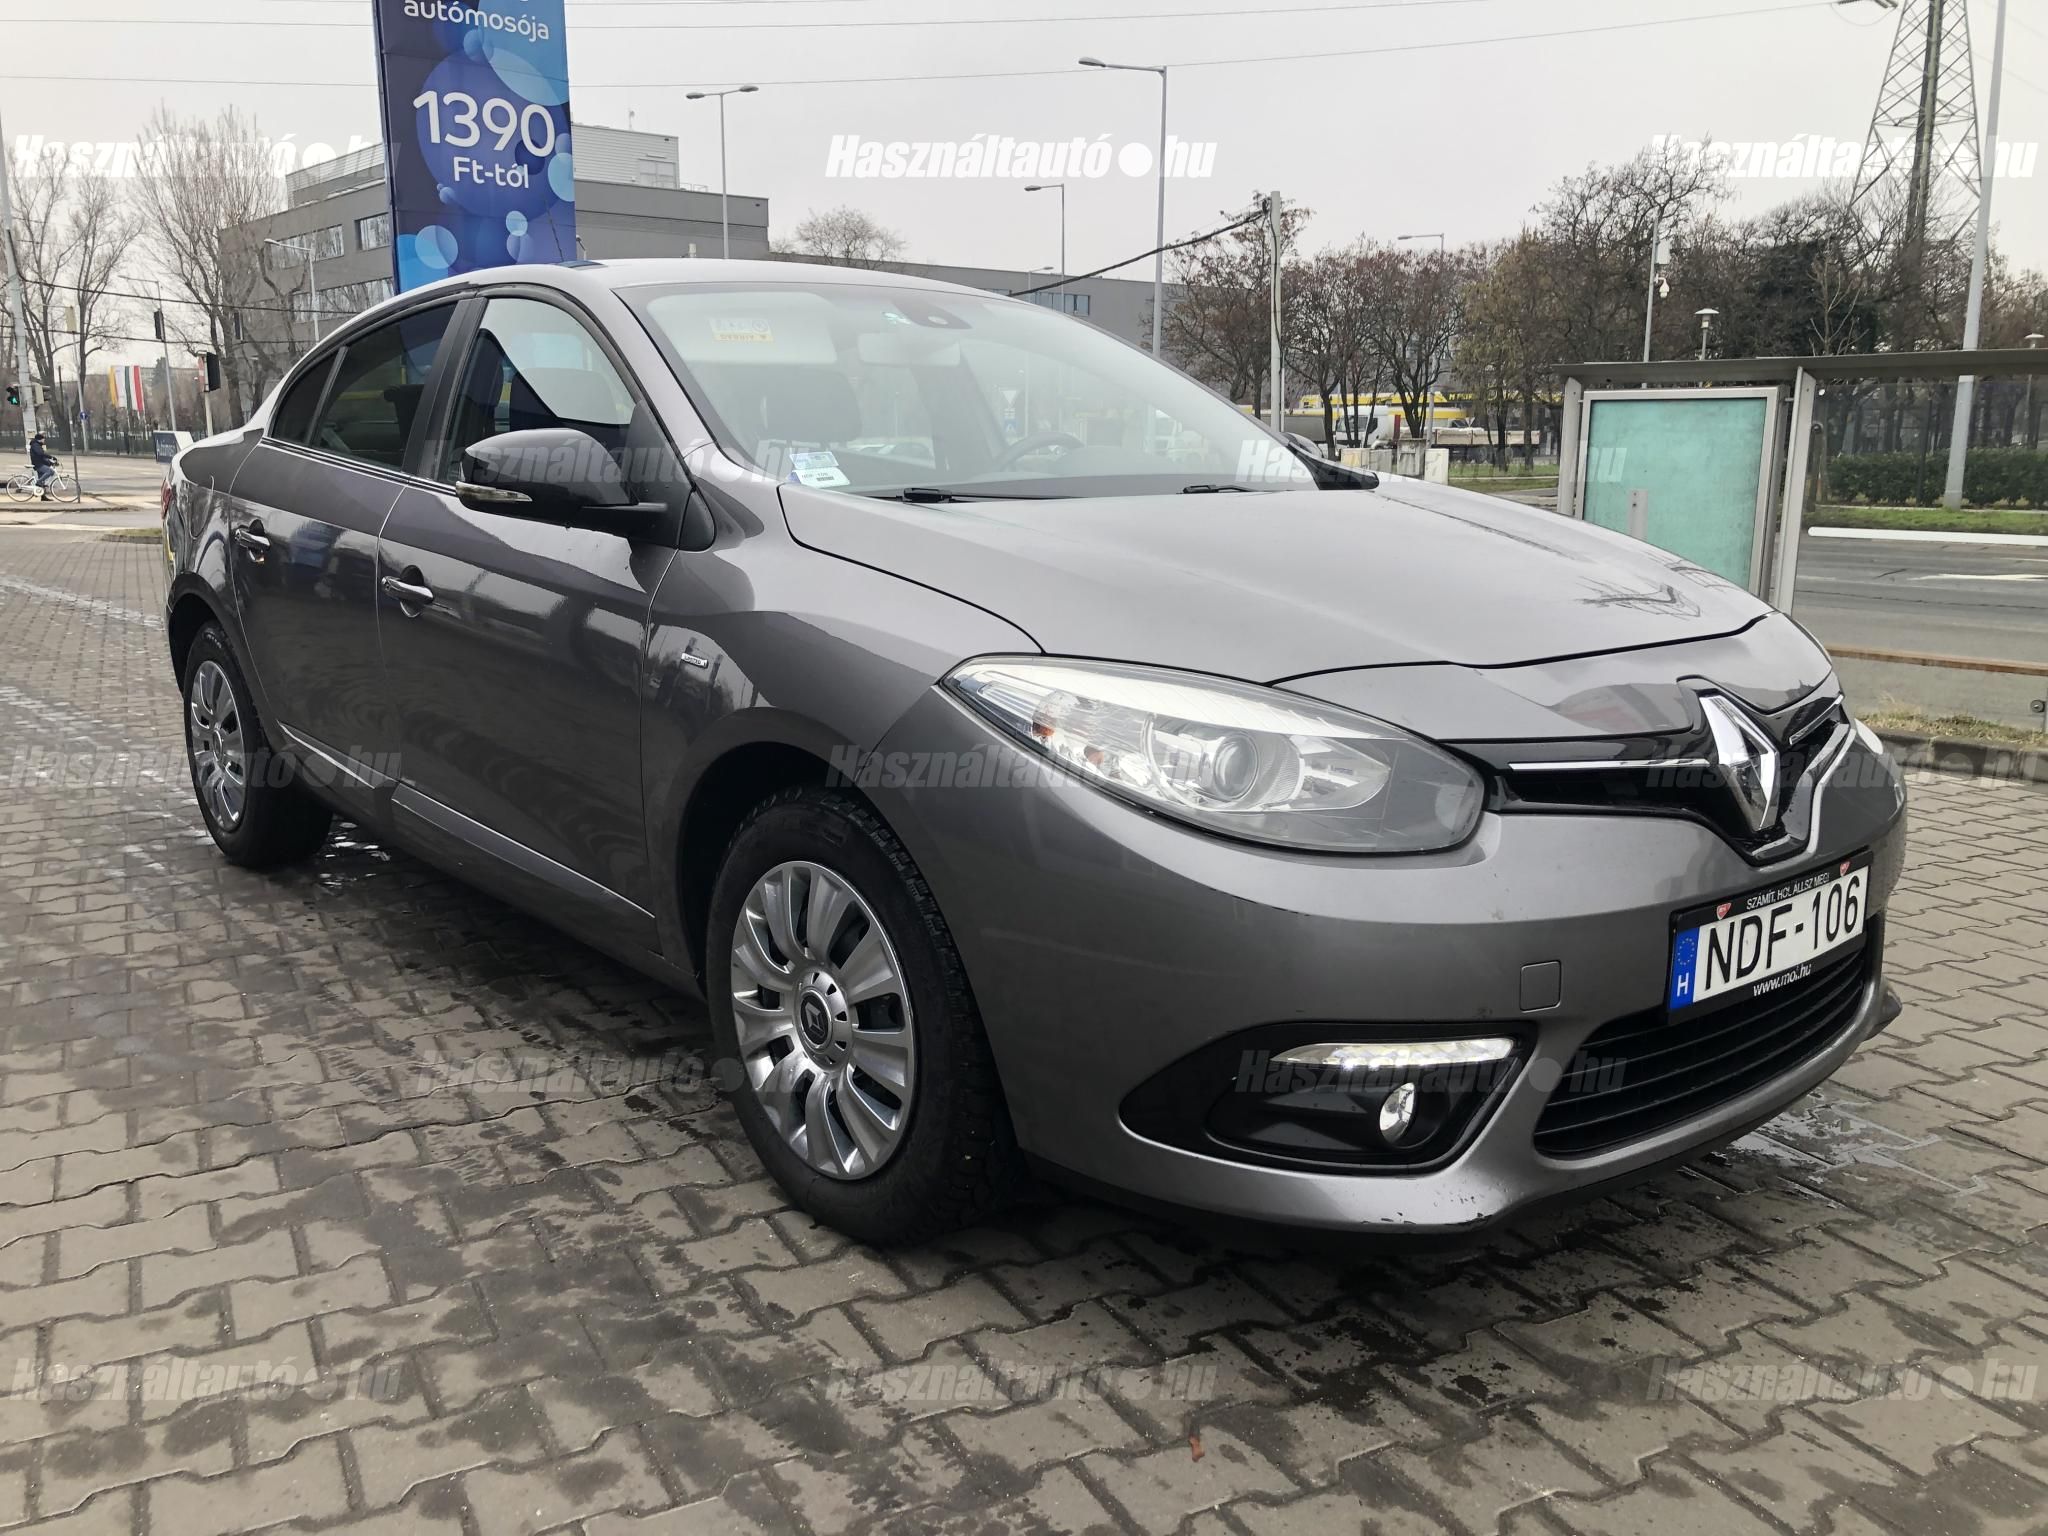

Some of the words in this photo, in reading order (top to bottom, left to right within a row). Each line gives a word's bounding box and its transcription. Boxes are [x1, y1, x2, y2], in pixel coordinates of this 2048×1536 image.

[403, 0, 549, 42] autómosója
[413, 91, 556, 157] 1390
[453, 156, 529, 189] Ft-tól
[1793, 877, 1813, 895] ÁLLSZ
[1705, 875, 1860, 991] NDF-106
[1676, 972, 1689, 997] H
